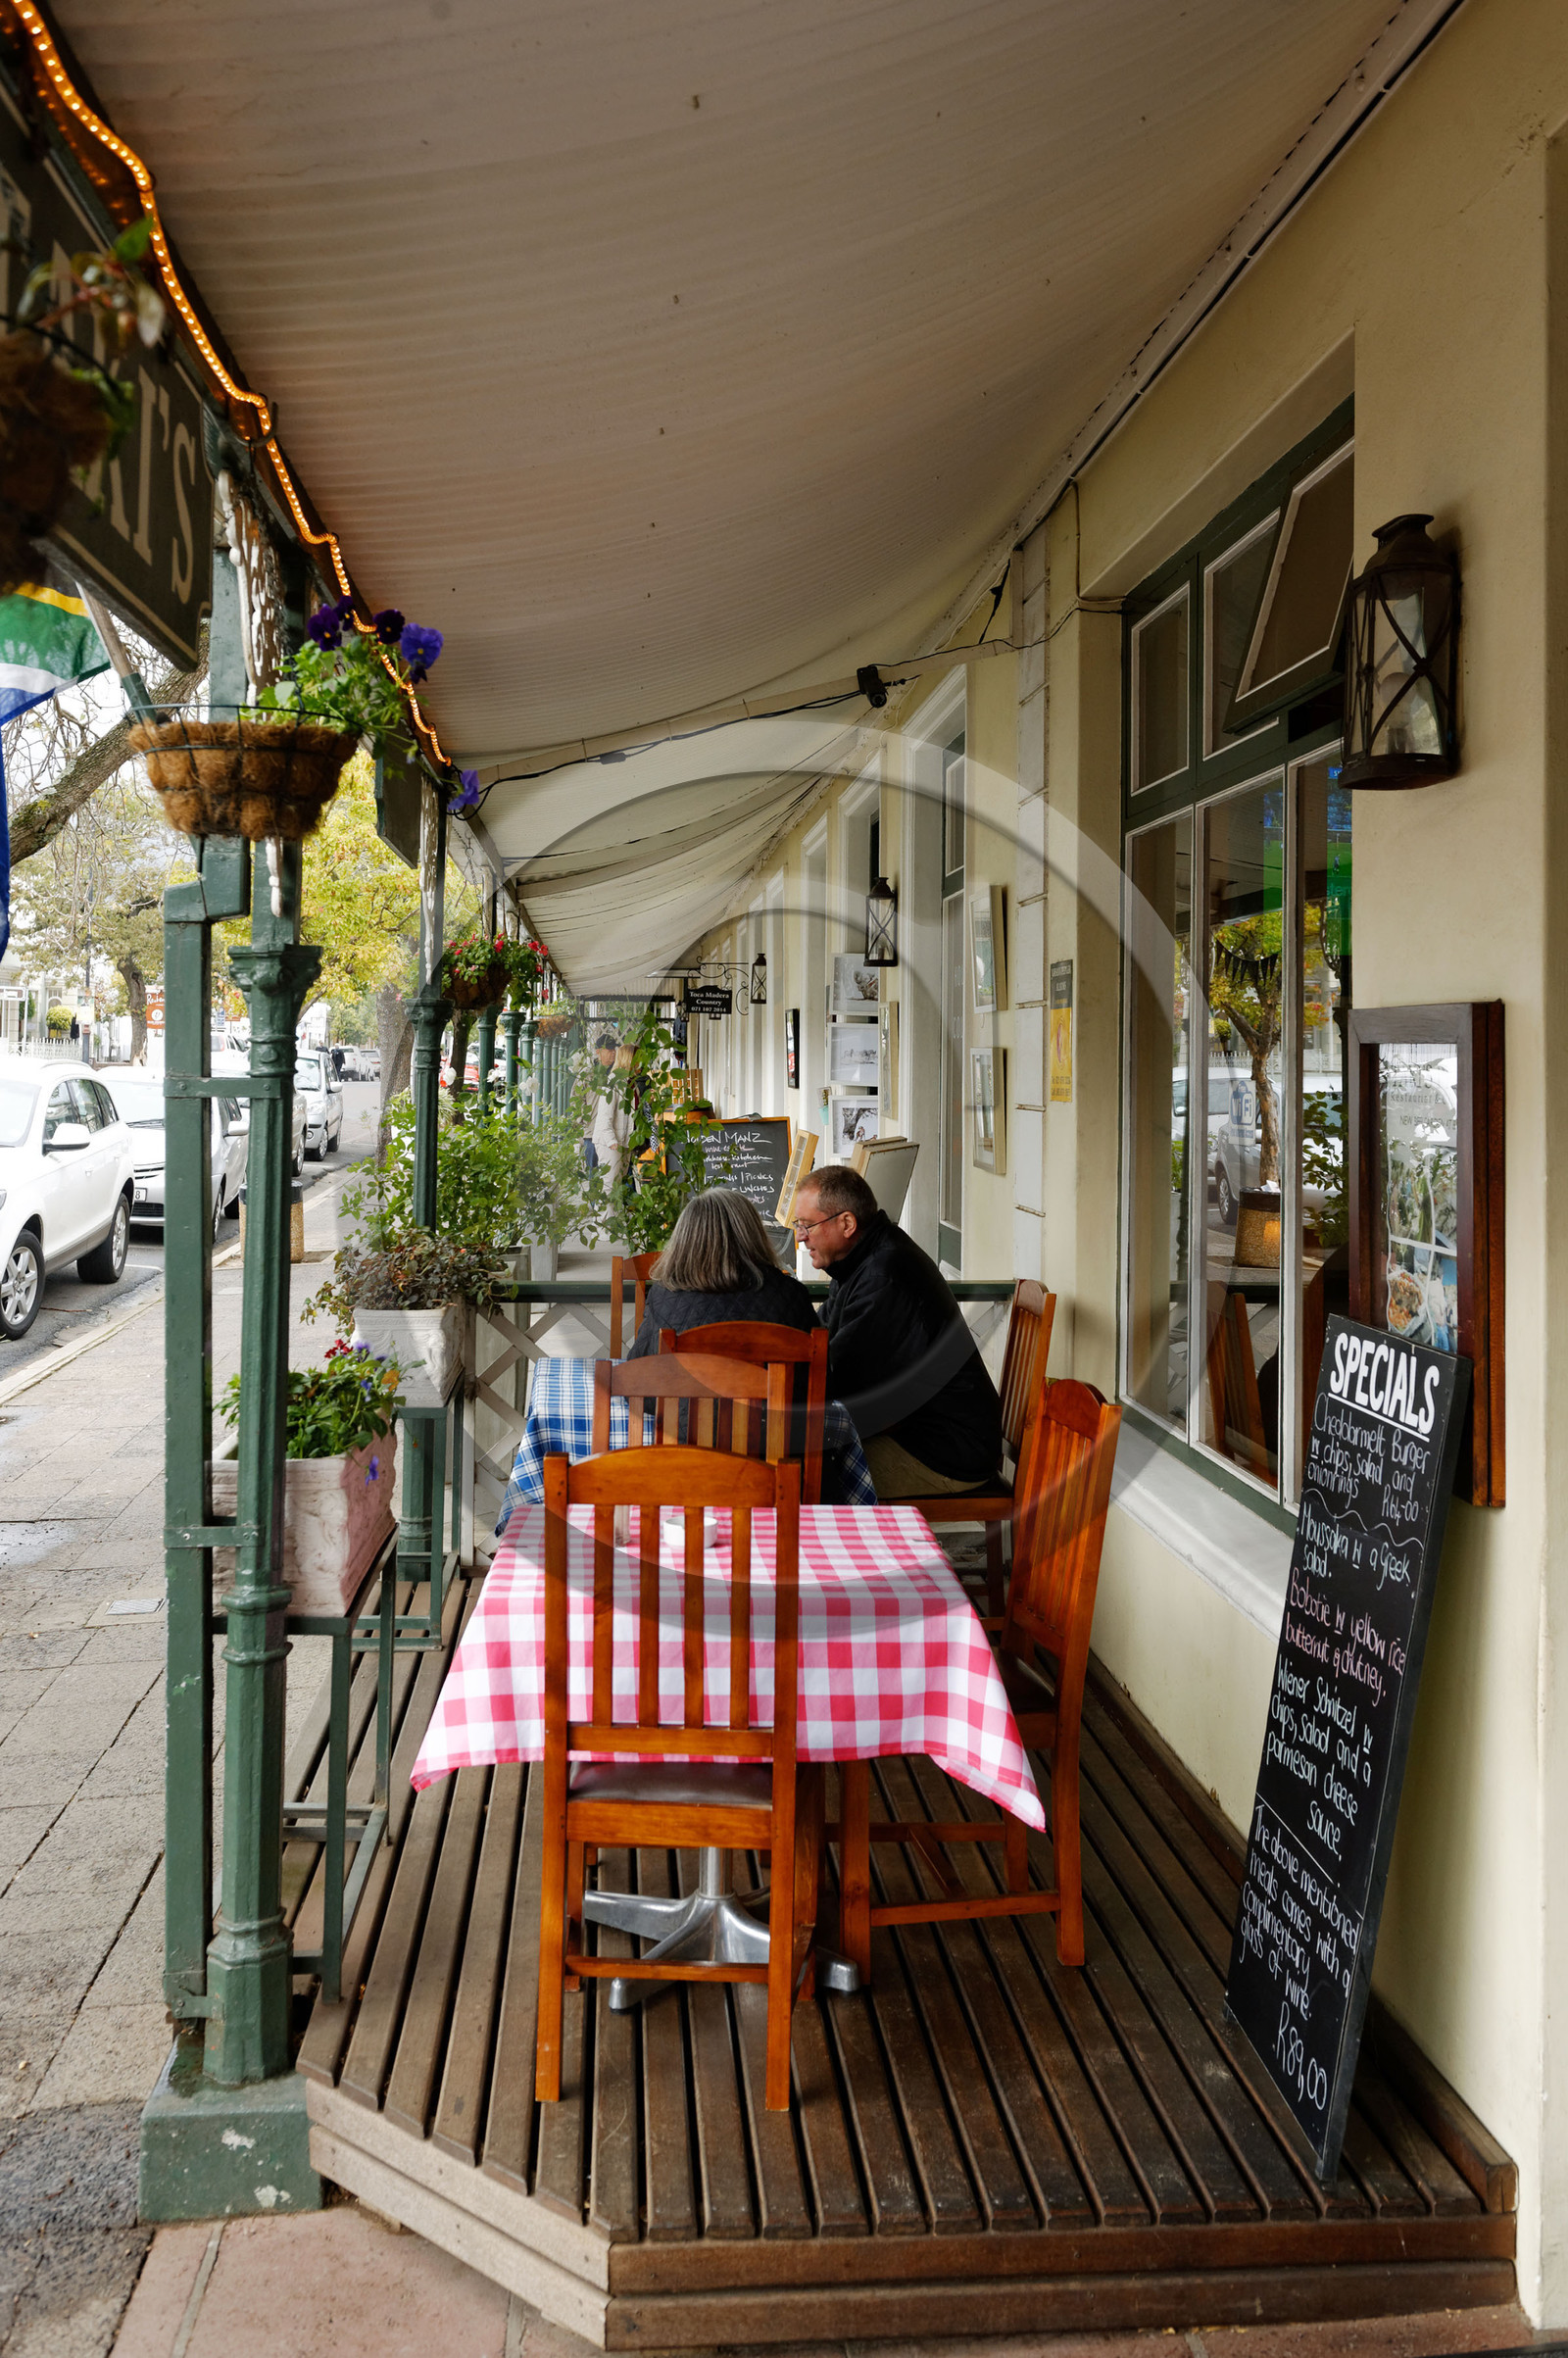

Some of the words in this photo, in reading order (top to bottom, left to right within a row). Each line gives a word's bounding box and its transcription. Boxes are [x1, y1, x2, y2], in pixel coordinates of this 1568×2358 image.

[724, 1131, 773, 1146] MANZ
[1330, 1333, 1440, 1434] SPECIALS
[1392, 1429, 1431, 1474] Burger
[1392, 1471, 1415, 1502] and
[1300, 1501, 1349, 1560] Moussaka
[1286, 1611, 1330, 1663] butternut
[1291, 1567, 1331, 1627] Bobotie
[1350, 1612, 1386, 1660] yellow
[1384, 1638, 1405, 1676] rice
[1278, 1653, 1310, 1703] Wiener
[1313, 1676, 1357, 1738] Schnitzel
[1337, 1739, 1360, 1779] and
[1363, 1761, 1371, 1788] a
[1324, 1764, 1358, 1826] cheese
[1255, 1804, 1270, 1853] The
[1271, 1828, 1299, 1884] above
[1300, 1868, 1360, 1955] mentioned
[1250, 1847, 1278, 1901] meals
[1282, 1890, 1311, 1942] comes
[1316, 1931, 1340, 1981] with
[1240, 1913, 1263, 1963] glass
[1268, 1945, 1283, 1981] of
